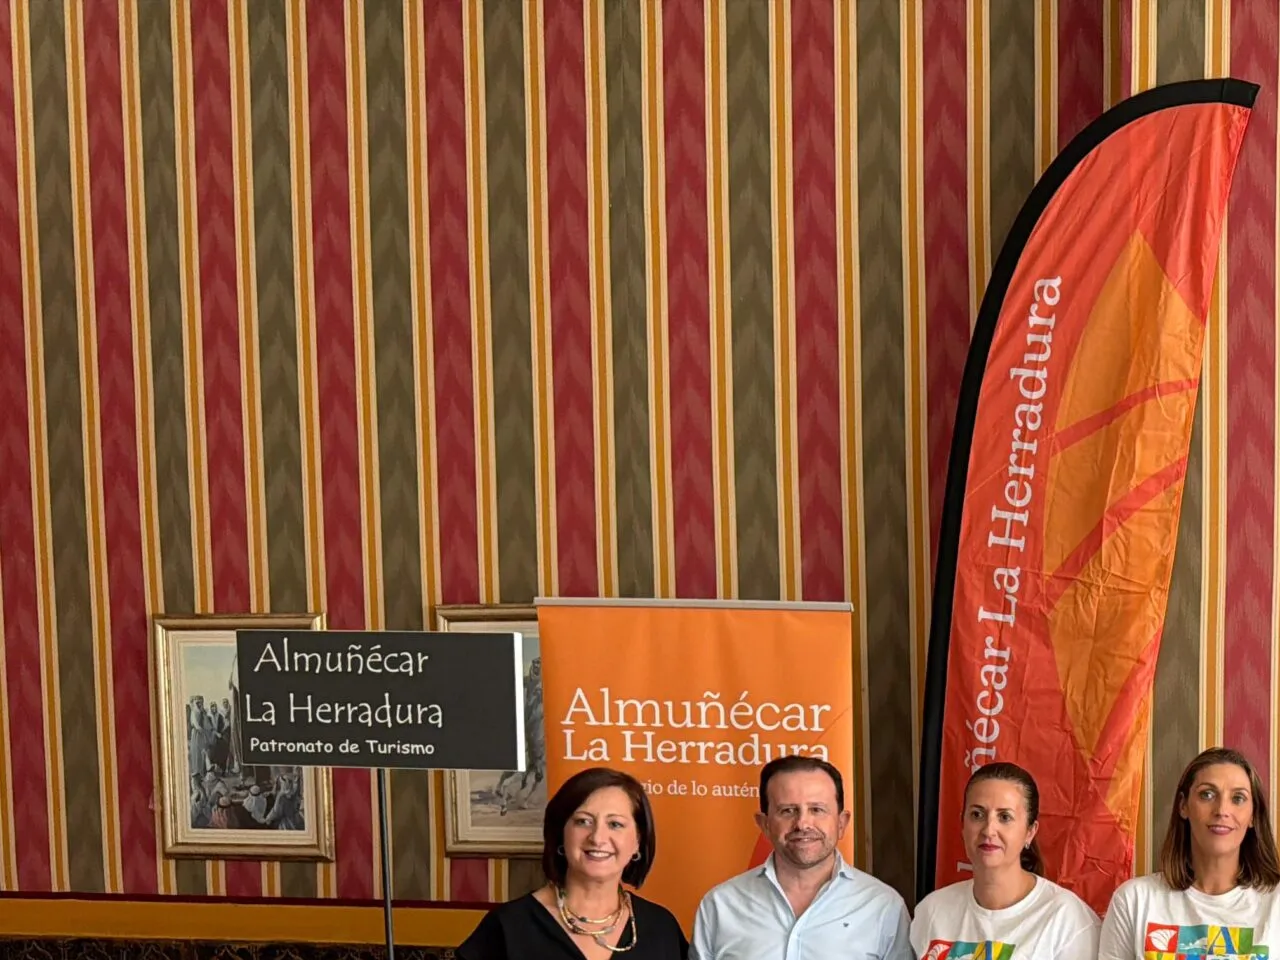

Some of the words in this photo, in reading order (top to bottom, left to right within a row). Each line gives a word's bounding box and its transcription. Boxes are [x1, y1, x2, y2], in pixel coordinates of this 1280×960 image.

[988, 275, 1062, 552] Herradura
[978, 566, 1021, 627] La
[254, 637, 429, 676] Almuñécar
[246, 694, 276, 725] La
[289, 693, 443, 728] Herradura
[560, 687, 831, 731] Almuñécar
[964, 636, 1011, 775] ñécar
[250, 738, 334, 753] Patronato
[339, 740, 360, 753] de
[366, 740, 435, 755] Turismo
[563, 729, 610, 761] La
[622, 732, 829, 765] Herradura
[667, 780, 688, 795] de
[691, 780, 708, 796] lo
[711, 781, 759, 798] autén
